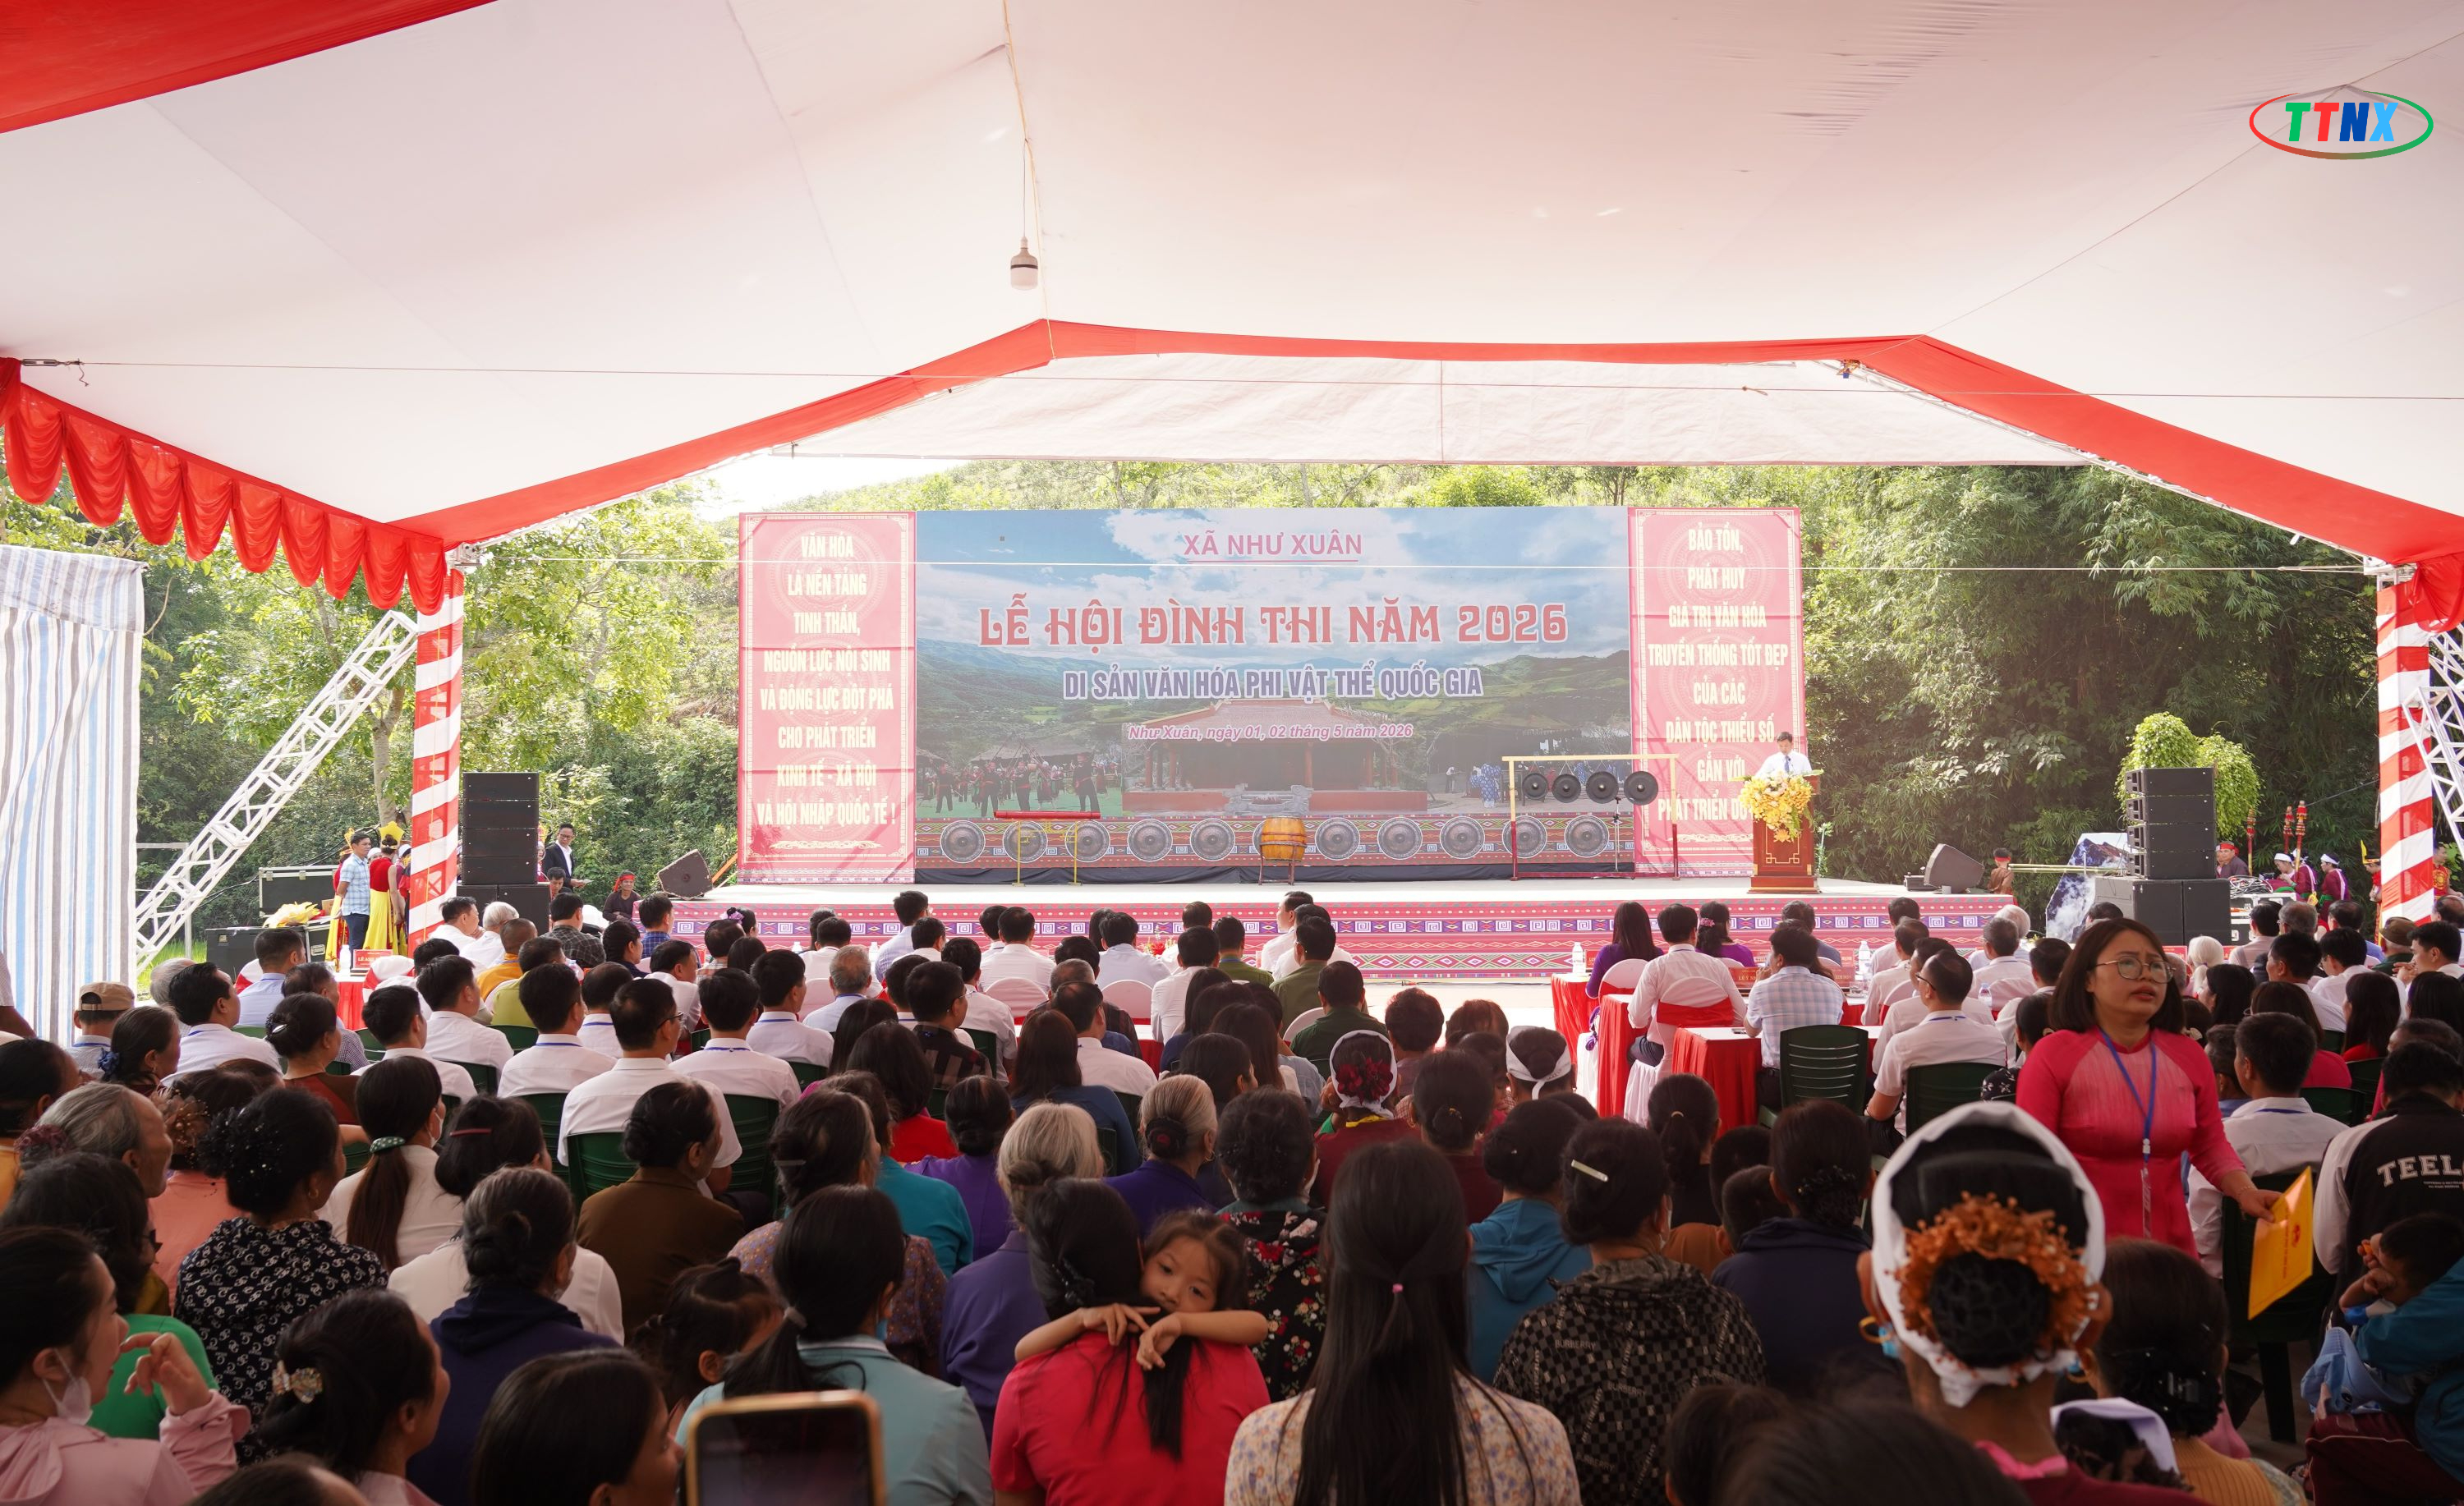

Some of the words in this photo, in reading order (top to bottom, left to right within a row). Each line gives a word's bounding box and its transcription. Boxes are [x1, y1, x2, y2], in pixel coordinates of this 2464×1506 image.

[802, 532, 825, 557] VĂN
[830, 532, 853, 557] HÓA
[1184, 530, 1219, 555] XÃ
[1228, 533, 1283, 555] NHƯ
[1291, 530, 1362, 555] XUÂN
[1689, 522, 1712, 550] BẢO
[788, 570, 802, 595] LÀ
[807, 567, 830, 595] NỀN
[835, 567, 867, 595] TẢNG
[1688, 562, 1718, 589] PHÁT
[1722, 568, 1745, 589] HUY
[794, 613, 821, 633] TINH
[980, 593, 1029, 645] LỄ
[1044, 599, 1122, 654] HỘI
[1138, 598, 1244, 644] ĐÌNH
[1260, 607, 1331, 643] THI
[1349, 597, 1441, 643] NĂM
[1458, 604, 1566, 642] 2026
[1669, 601, 1689, 627] GIÁ
[1693, 606, 1712, 631] TRỊ
[1714, 601, 1739, 627] VĂN
[1742, 601, 1767, 627] HÓA
[810, 649, 832, 676] LỰC
[836, 645, 857, 676] NỘI
[861, 650, 890, 671] SINH
[1648, 637, 1694, 665] TRUYỀN
[1698, 636, 1737, 665] THỐNG
[1740, 636, 1761, 665] TỐT
[1765, 645, 1788, 670] ĐẸP
[1065, 673, 1085, 697] DI
[1093, 663, 1137, 697] SẢN
[1144, 668, 1188, 697] VĂN
[1196, 667, 1239, 696] HÓA
[1246, 671, 1281, 696] PHI
[1289, 668, 1327, 700] VẬT
[1335, 661, 1374, 696] THỂ
[1381, 662, 1437, 698] QUỐC
[1446, 669, 1482, 695] GIA
[1694, 675, 1717, 705] CỦA
[1721, 678, 1745, 705] CÁC
[761, 684, 776, 709] VÀ
[779, 684, 812, 714] ĐỘNG
[816, 686, 839, 714] LỰC
[843, 683, 866, 714] ĐỘT
[869, 683, 894, 709] PHÁ
[779, 727, 802, 748] CHO
[806, 722, 837, 748] PHÁT
[841, 718, 876, 748] TRIỂN
[1129, 726, 1160, 739] Như
[1162, 724, 1202, 741] Xuân,
[1207, 726, 1241, 742] ngày
[1270, 726, 1286, 737] 02
[1290, 724, 1329, 741] tháng
[1333, 725, 1342, 737] 5
[1345, 725, 1377, 737] năm
[1380, 723, 1413, 737] 2026
[1666, 717, 1691, 742] DÂN
[1694, 716, 1717, 748] TỘC
[1721, 712, 1754, 742] THIỂU
[1758, 713, 1775, 742] SỐ
[777, 765, 807, 786] KINH
[810, 758, 824, 786] TẾ
[836, 761, 853, 786] XÃ
[856, 760, 876, 790] HỘI
[1698, 751, 1722, 781] GẮN
[1726, 755, 1745, 780] VỚI
[757, 798, 773, 824] VÀ
[776, 798, 797, 829] HỘI
[800, 797, 834, 829] NHẬP
[837, 795, 870, 827] QUỐC
[874, 796, 888, 824] TẾ
[1693, 789, 1727, 820] TRIỂN
[2376, 1154, 2463, 1187] TEEL
